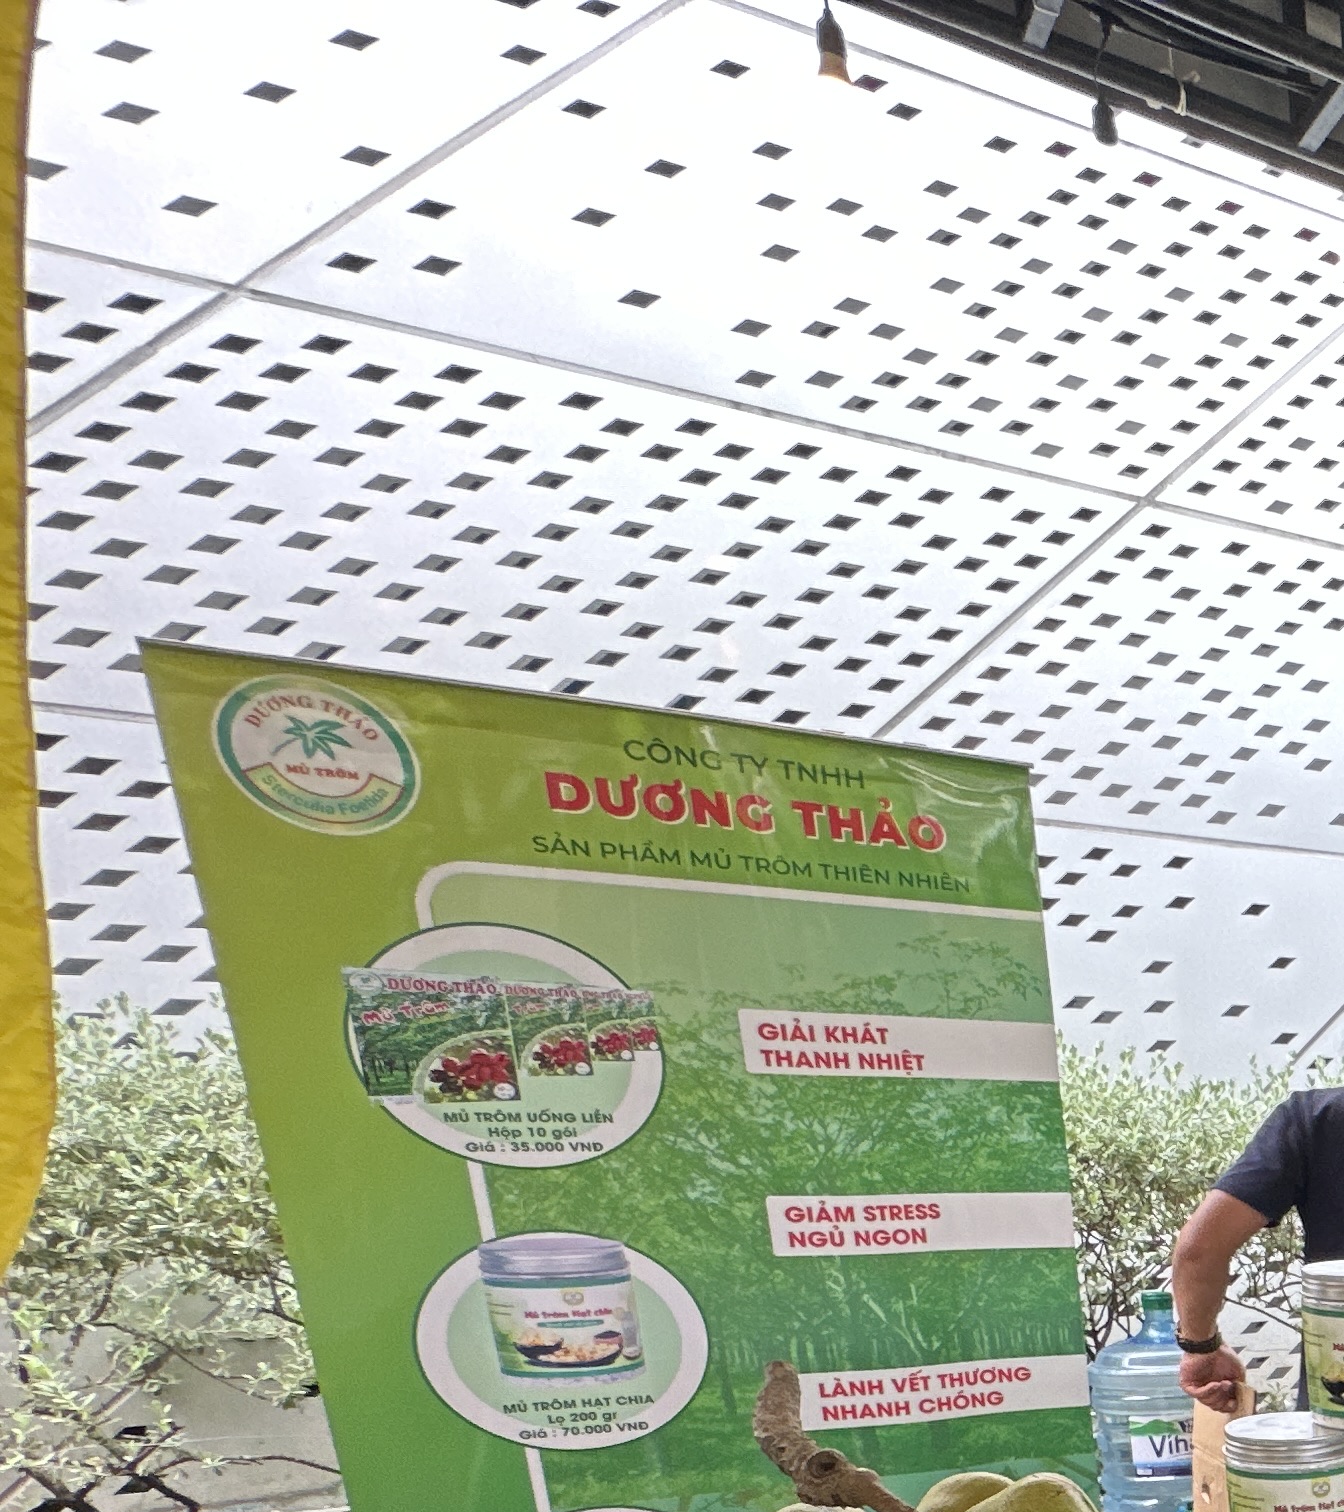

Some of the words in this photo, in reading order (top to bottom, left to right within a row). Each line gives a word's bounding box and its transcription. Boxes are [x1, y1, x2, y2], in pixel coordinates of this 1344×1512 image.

[623, 737, 723, 771] CÔNG
[731, 753, 768, 775] TY
[777, 759, 865, 789] TNHH
[544, 771, 776, 833] DƯƠNG
[790, 797, 947, 852] THẢO
[532, 831, 591, 857] SẢN
[600, 835, 682, 865] PHẨM
[691, 848, 732, 870] MỦ
[739, 855, 812, 878] TRÔM
[819, 863, 890, 885] THIÊN
[898, 870, 970, 893] NHIÊN
[757, 1018, 815, 1042] GIẢI
[824, 1021, 888, 1045] KHÁT
[760, 1049, 850, 1069] THANH
[859, 1049, 925, 1076] NHIỆT
[527, 1127, 547, 1138] 10
[551, 1127, 578, 1141] gói
[785, 1200, 855, 1223] GIẢM
[863, 1203, 940, 1221] STRESS
[788, 1224, 844, 1247] NGỦ
[854, 1228, 928, 1246] NGON
[818, 1377, 884, 1398] LÀNH
[892, 1367, 930, 1393] VẾT
[937, 1366, 1031, 1389] THƯƠNG
[502, 1401, 529, 1415] MỦ
[532, 1398, 577, 1411] TRÔM
[579, 1395, 613, 1411] HẠT
[615, 1393, 655, 1406] CHIA
[569, 1411, 598, 1422] 200
[821, 1401, 911, 1422] NHANH
[918, 1389, 1004, 1414] CHÓNG
[518, 1427, 547, 1441] Giá
[562, 1424, 612, 1437] 70.000
